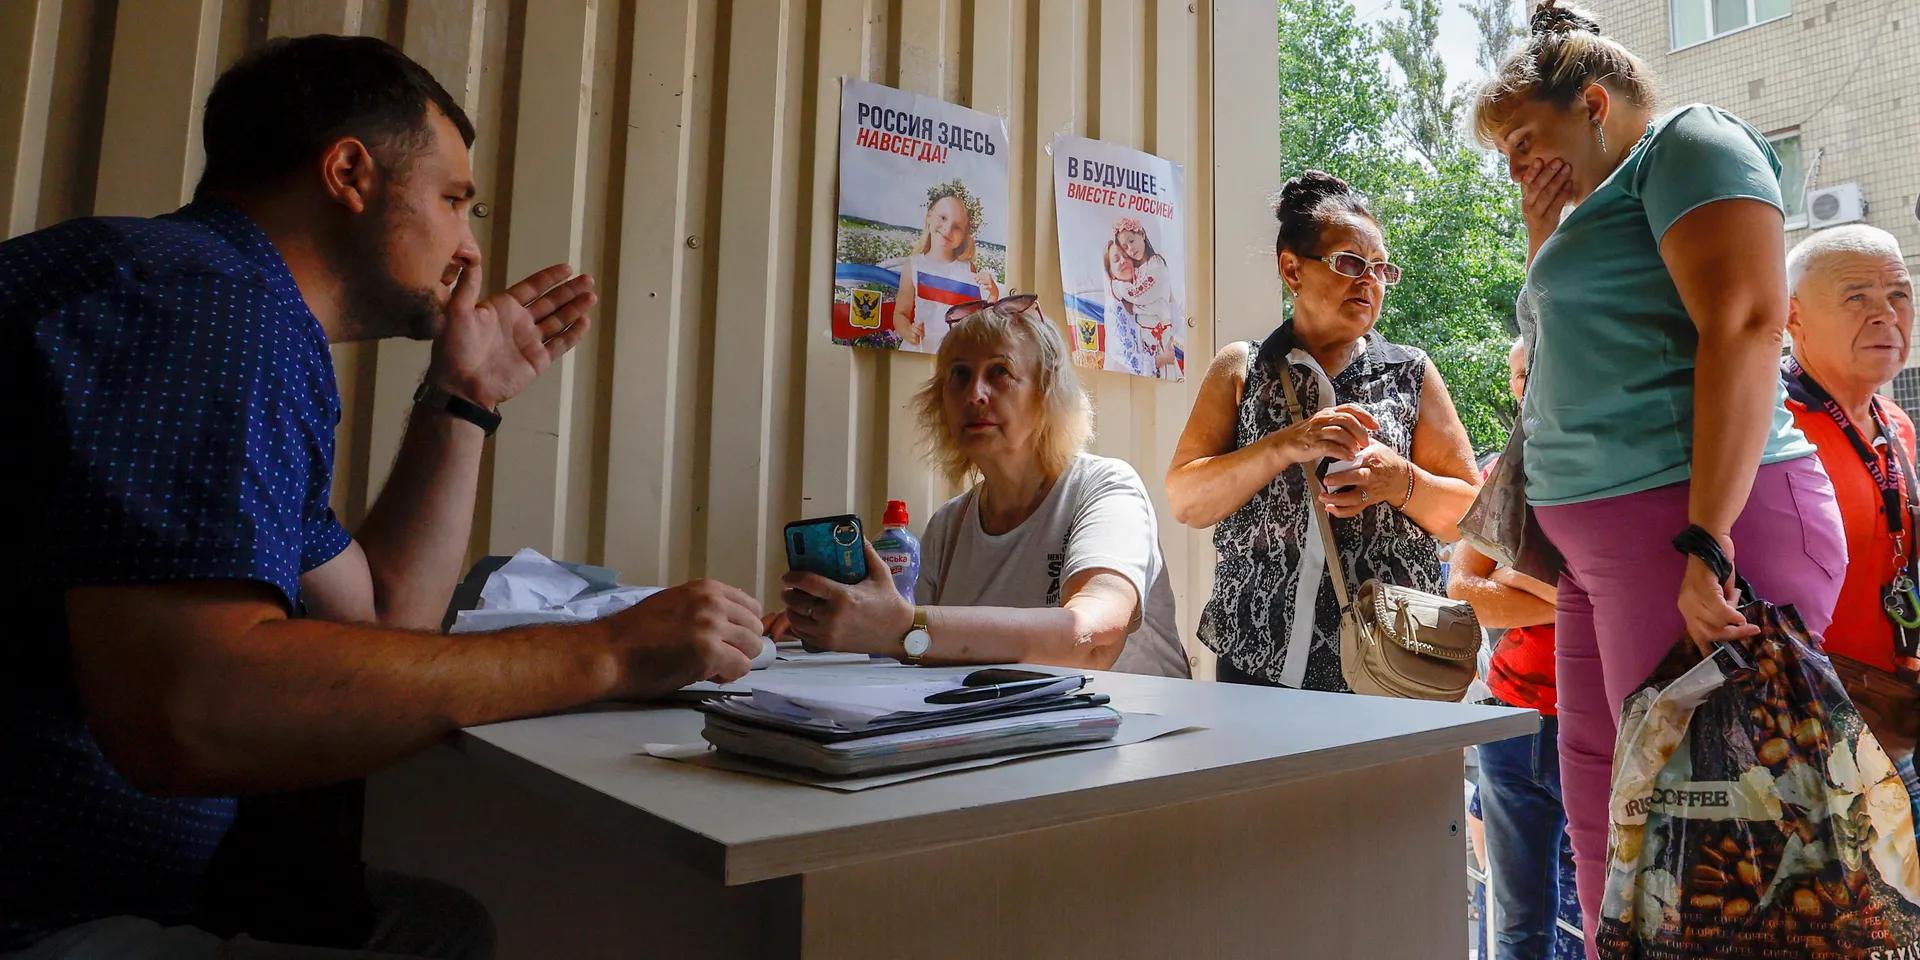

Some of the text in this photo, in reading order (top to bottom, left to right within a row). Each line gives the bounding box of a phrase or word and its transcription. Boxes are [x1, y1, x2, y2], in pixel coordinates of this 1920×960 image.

[856, 127, 948, 164] НАВСЕГДА!
[858, 102, 996, 156] РОССИЯ ЗДЕСЬ
[1068, 156, 1079, 178] В
[1083, 159, 1157, 196] БУДУЩЕЕ
[1067, 182, 1175, 220] ВМЕСТЕ С РОССИЕЙ
[1823, 400, 1850, 429] KULT
[1865, 460, 1889, 491] KULT
[1888, 458, 1898, 489] KULT
[1651, 788, 1729, 807] COFFEE
